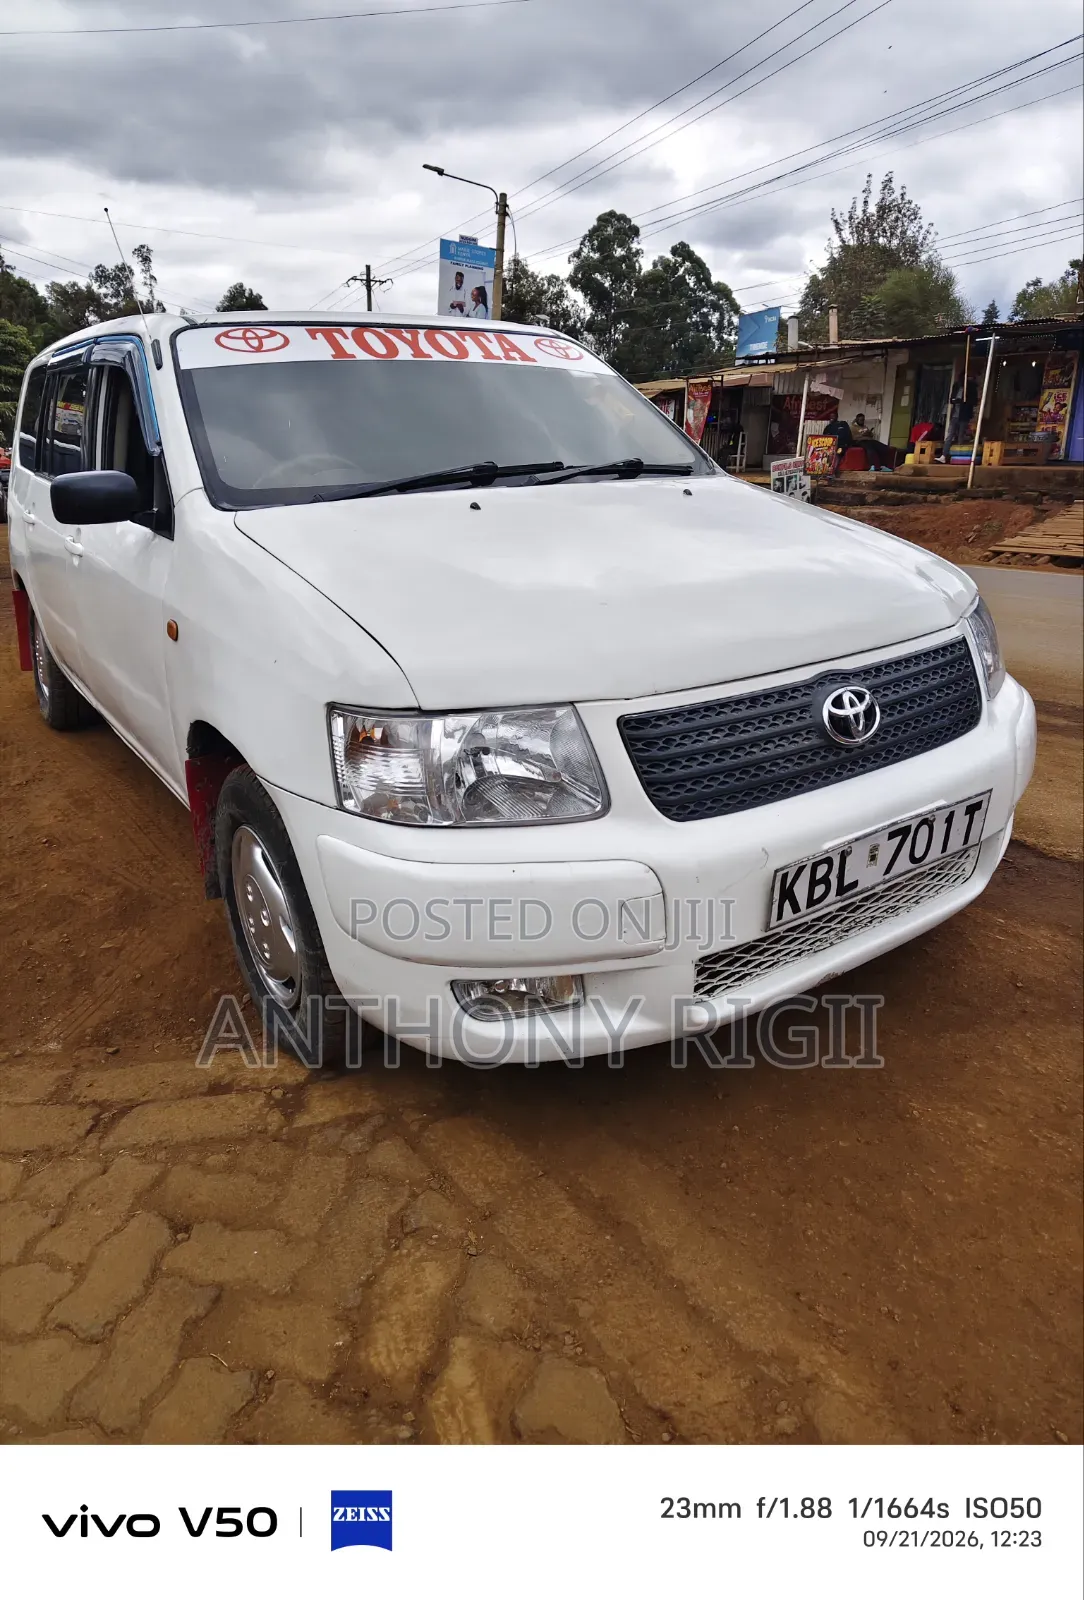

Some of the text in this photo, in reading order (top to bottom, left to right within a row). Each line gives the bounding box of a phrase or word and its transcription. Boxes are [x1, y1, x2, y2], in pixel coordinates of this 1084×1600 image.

[311, 327, 537, 363] TOYOTA
[776, 799, 984, 922] KBL 701T
